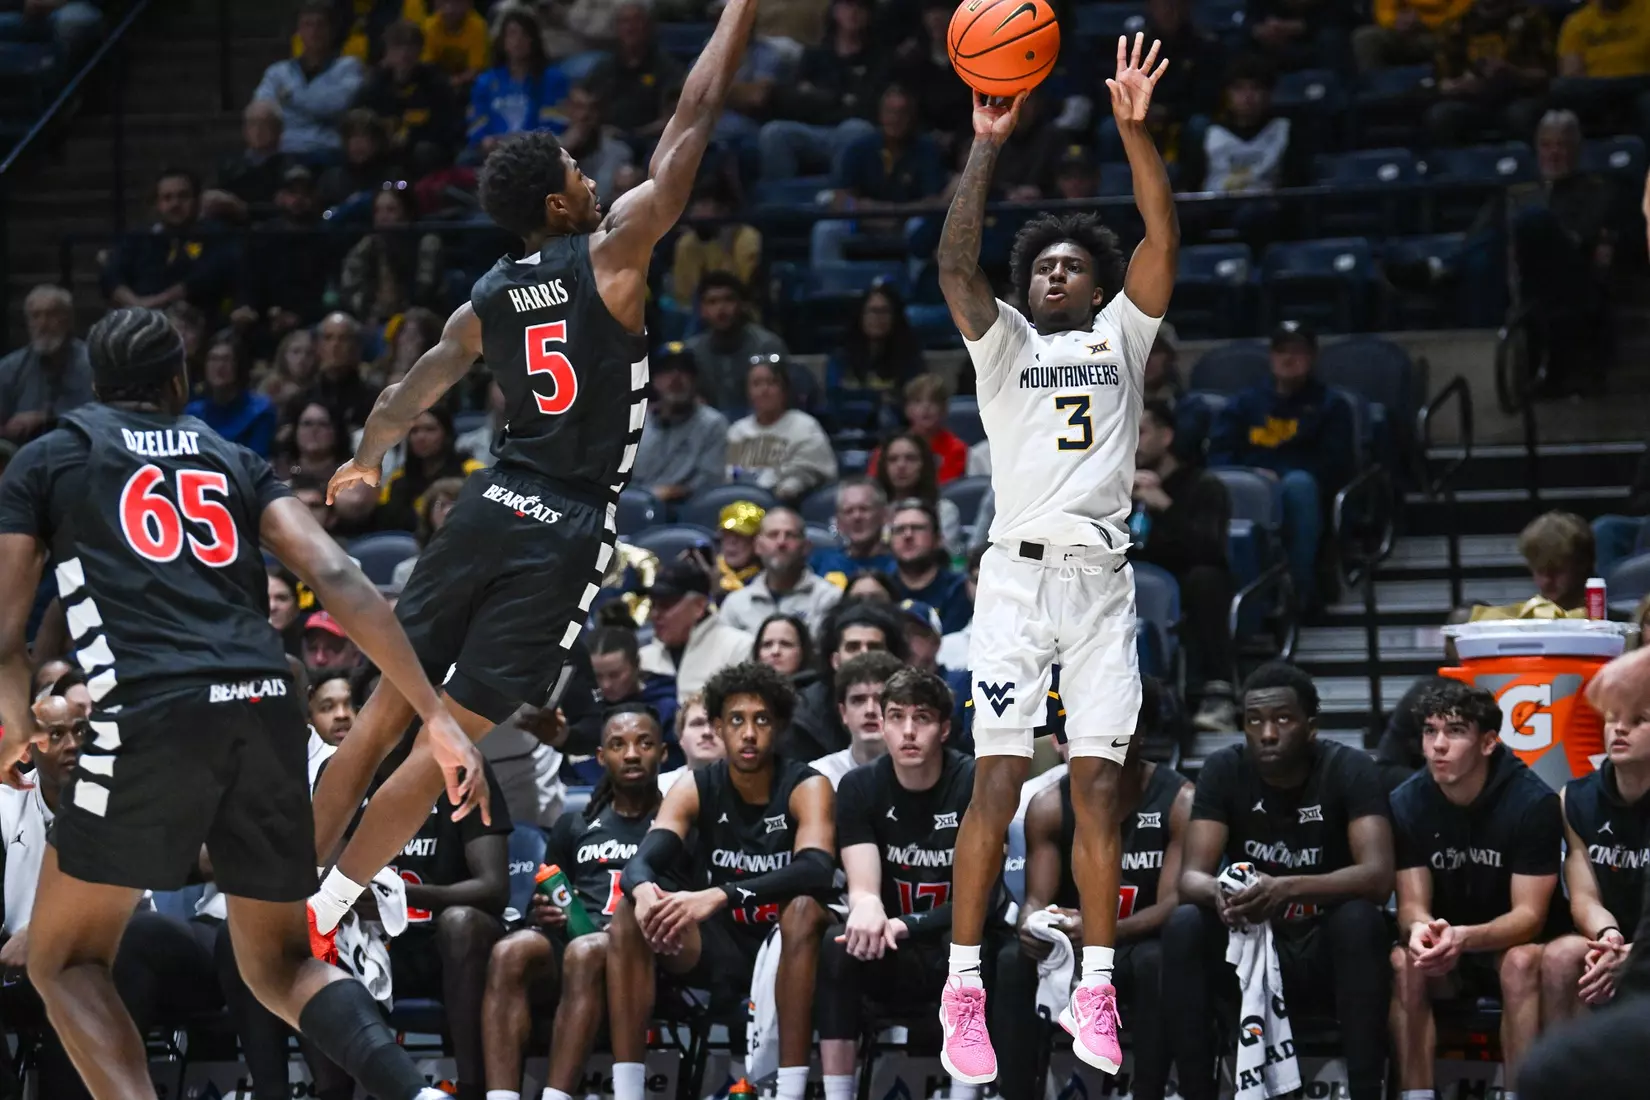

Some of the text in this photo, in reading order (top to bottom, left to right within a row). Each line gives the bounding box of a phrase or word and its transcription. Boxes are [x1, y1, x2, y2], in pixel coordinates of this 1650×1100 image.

[508, 279, 569, 313] HARRIS
[525, 320, 578, 415] 5
[1020, 364, 1119, 388] MOUNTAINEERS
[121, 428, 199, 457] DZELLAT
[1055, 394, 1094, 451] 3
[119, 464, 239, 567] 65
[482, 484, 563, 524] BEARCATS
[1498, 684, 1553, 751] G
